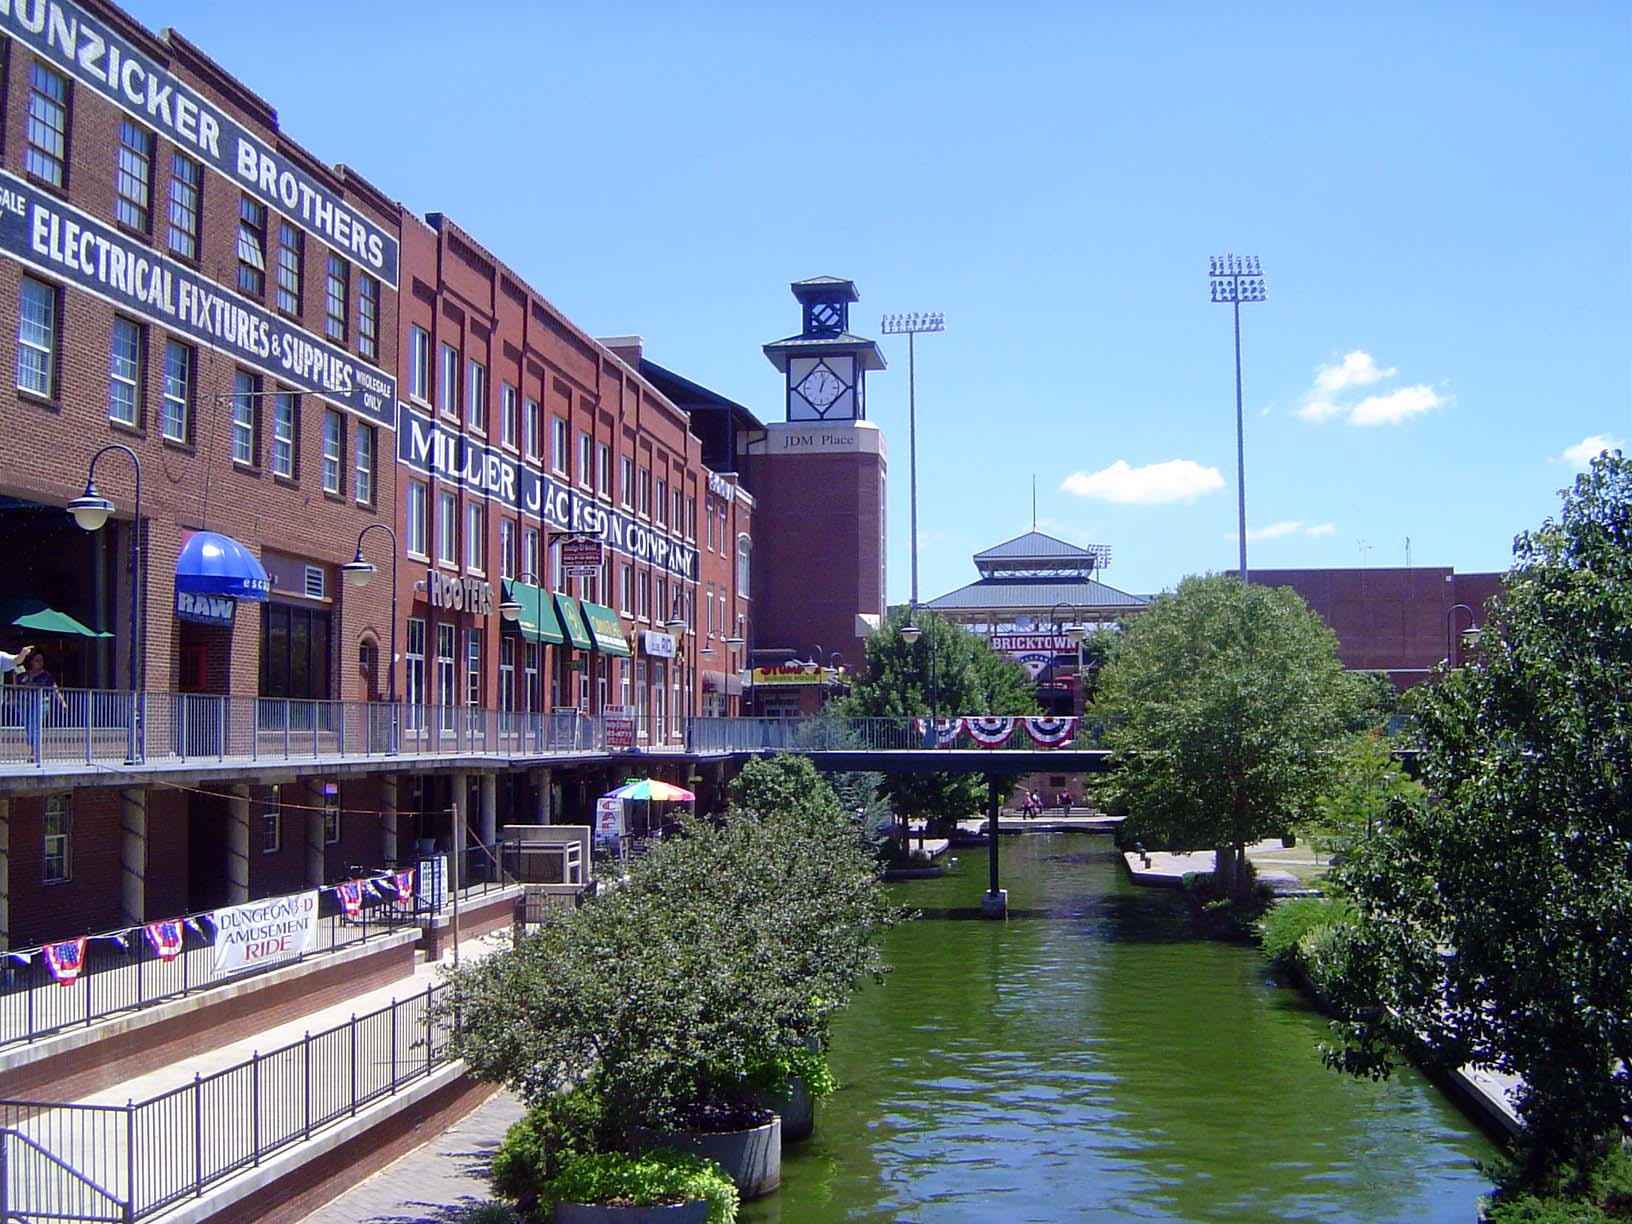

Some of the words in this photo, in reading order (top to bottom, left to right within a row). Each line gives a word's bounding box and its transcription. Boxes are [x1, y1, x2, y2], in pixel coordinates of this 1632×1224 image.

[0, 0, 220, 158] UNZICKER
[236, 137, 384, 268] BROTHERS
[33, 204, 176, 316] ELECTRICAL
[179, 278, 269, 359] FIXTURES
[271, 334, 282, 357] &
[282, 337, 353, 397] SUPPLIES
[355, 369, 391, 398] WHOLESALE
[364, 392, 382, 412] ONLY
[783, 435, 814, 448] JDM
[821, 434, 855, 446] Place
[410, 420, 516, 501] MILLER
[526, 483, 622, 546] JACKSON
[626, 524, 693, 575] COMPANY
[178, 592, 234, 619] RAW
[427, 569, 494, 616] HOOTERS
[992, 636, 1077, 650] BRICKTOWN
[221, 903, 291, 930] DUNGEON
[225, 917, 309, 944] AMUSEMENT
[245, 935, 293, 961] RIDE
